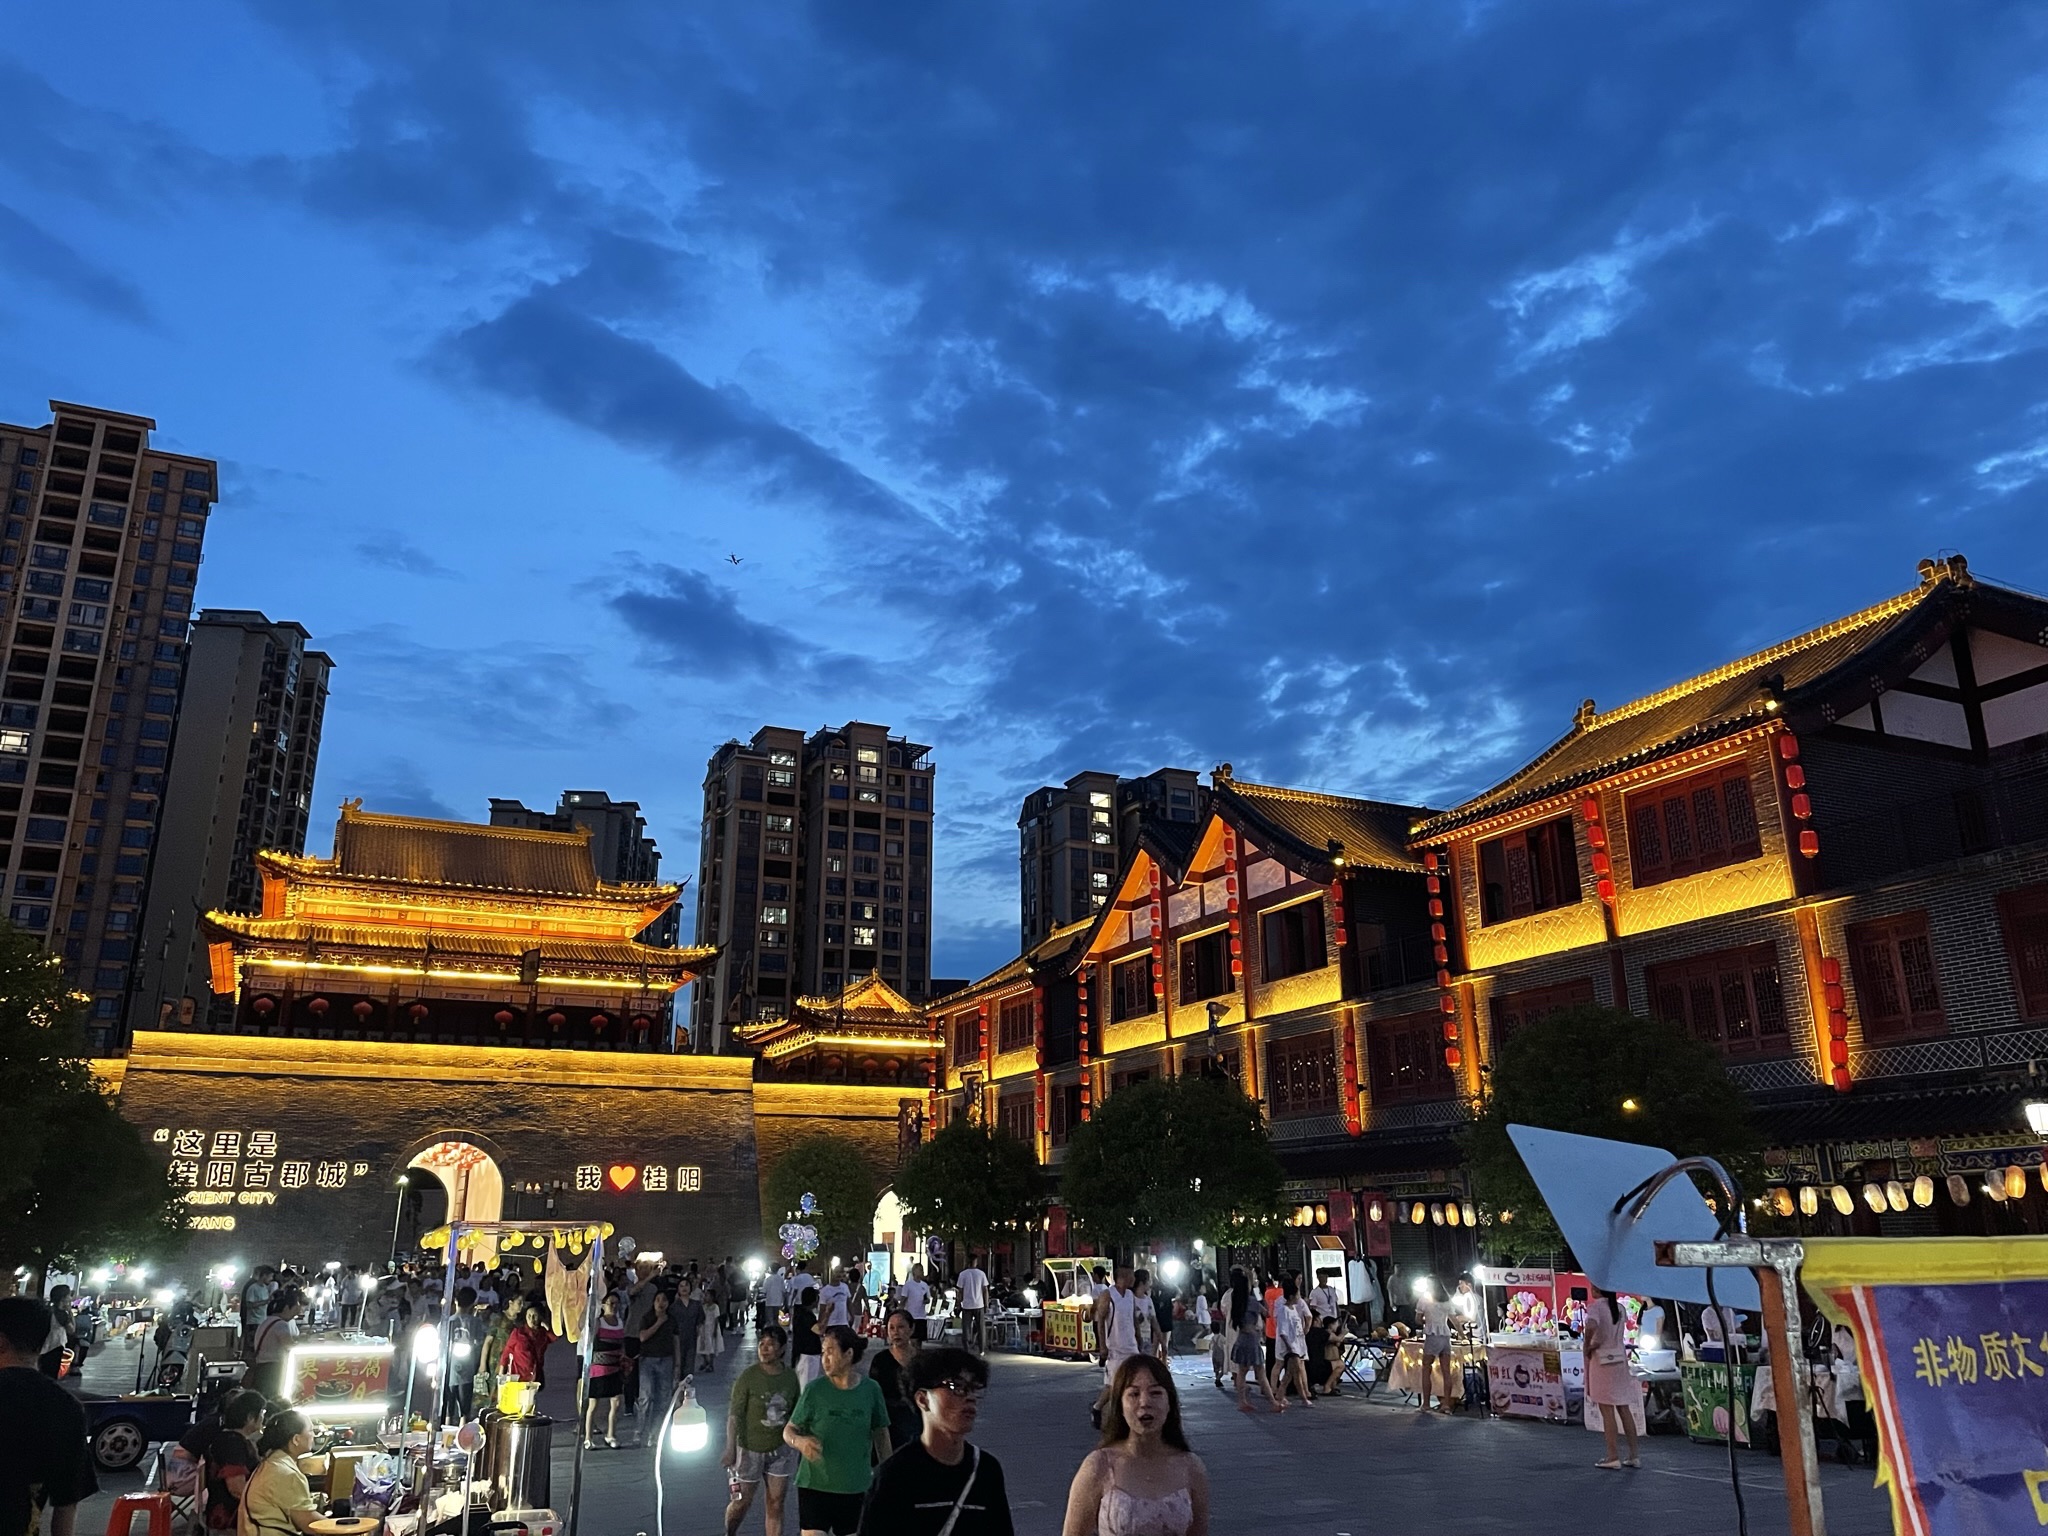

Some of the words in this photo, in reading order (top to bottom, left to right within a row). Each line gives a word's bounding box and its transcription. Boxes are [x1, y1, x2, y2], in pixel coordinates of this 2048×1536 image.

[576, 1165, 602, 1191] 我
[643, 1165, 701, 1192] 桂阳
[178, 1190, 235, 1205] CIENT
[237, 1191, 277, 1205] CITY
[1913, 1331, 2048, 1387] 非物质文
